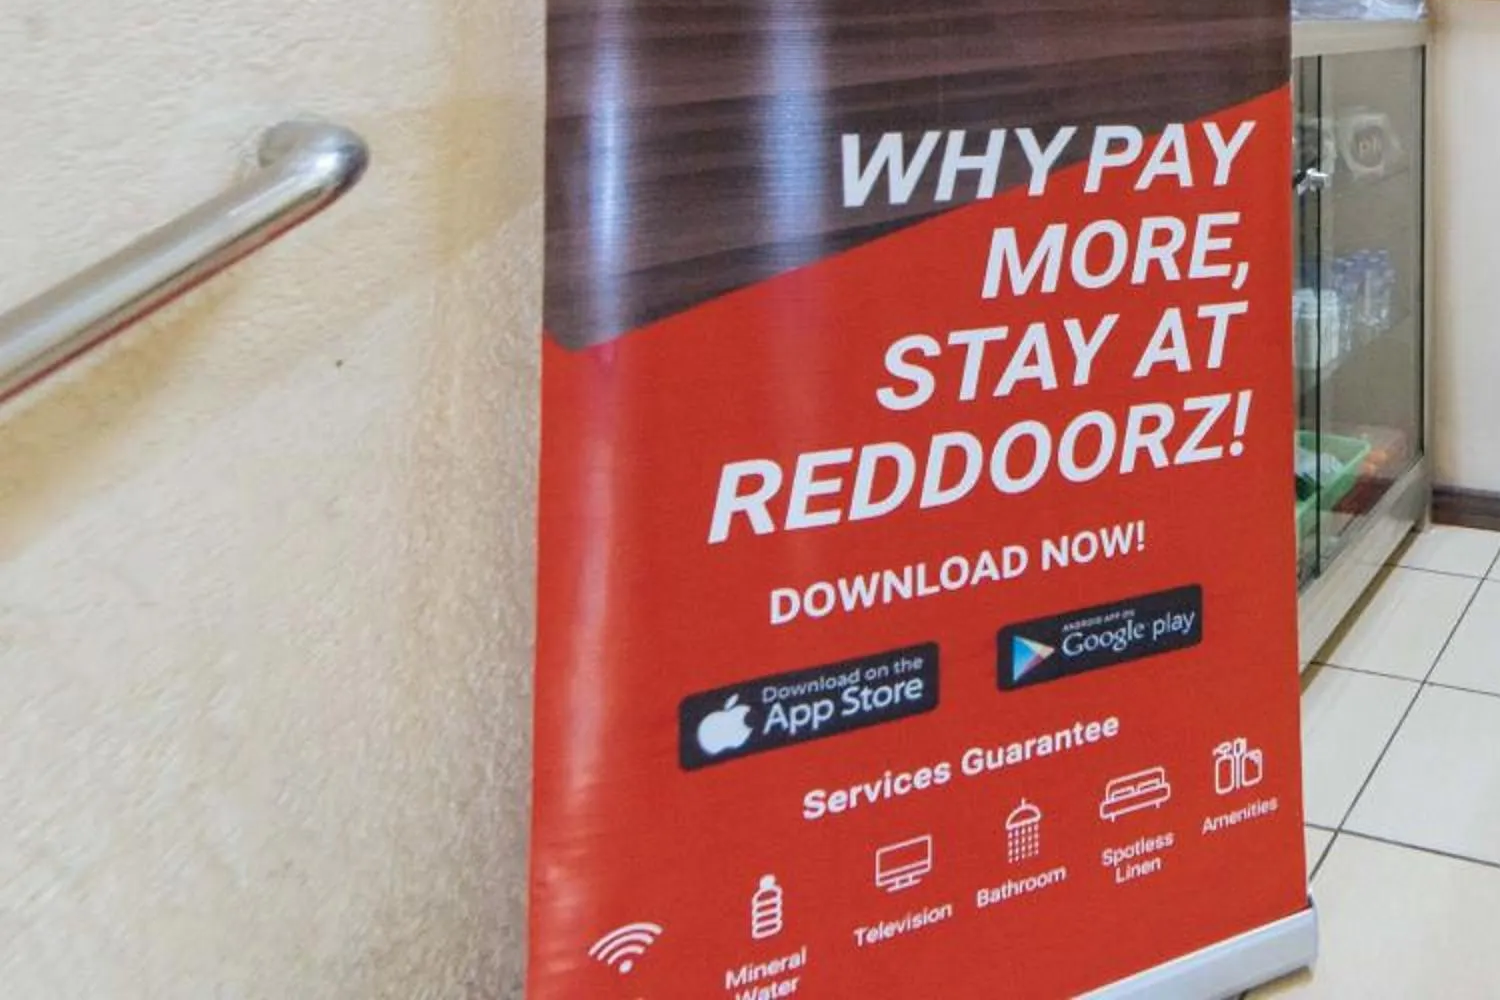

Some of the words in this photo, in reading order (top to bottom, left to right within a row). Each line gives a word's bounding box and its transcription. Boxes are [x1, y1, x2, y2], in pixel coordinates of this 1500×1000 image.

[841, 126, 1077, 208] WHY
[1082, 120, 1257, 194] PAY
[981, 211, 1249, 300] MORE,
[876, 313, 1120, 412] STAY
[1131, 300, 1249, 379] AT
[707, 389, 1253, 544] REDDOORZ!
[769, 547, 1029, 625] DOWNLOAD
[1041, 520, 1146, 572] NOW!
[1062, 616, 1103, 632] ANDROID
[1103, 610, 1121, 624] APP
[1122, 608, 1136, 619] ON
[1062, 618, 1146, 657] Google
[1152, 609, 1196, 641] play
[761, 667, 861, 704] Download
[864, 664, 889, 681] on
[892, 656, 924, 675] the
[763, 697, 835, 736] App
[841, 676, 924, 718] Store
[802, 761, 951, 821] Services
[961, 715, 1120, 776] Guarantee
[1202, 795, 1279, 835] Amenities
[1101, 830, 1175, 868] Spotless
[1115, 854, 1162, 885] Linen
[976, 863, 1067, 908] Bathroom
[854, 900, 953, 948] Television
[725, 944, 807, 990] Mineral
